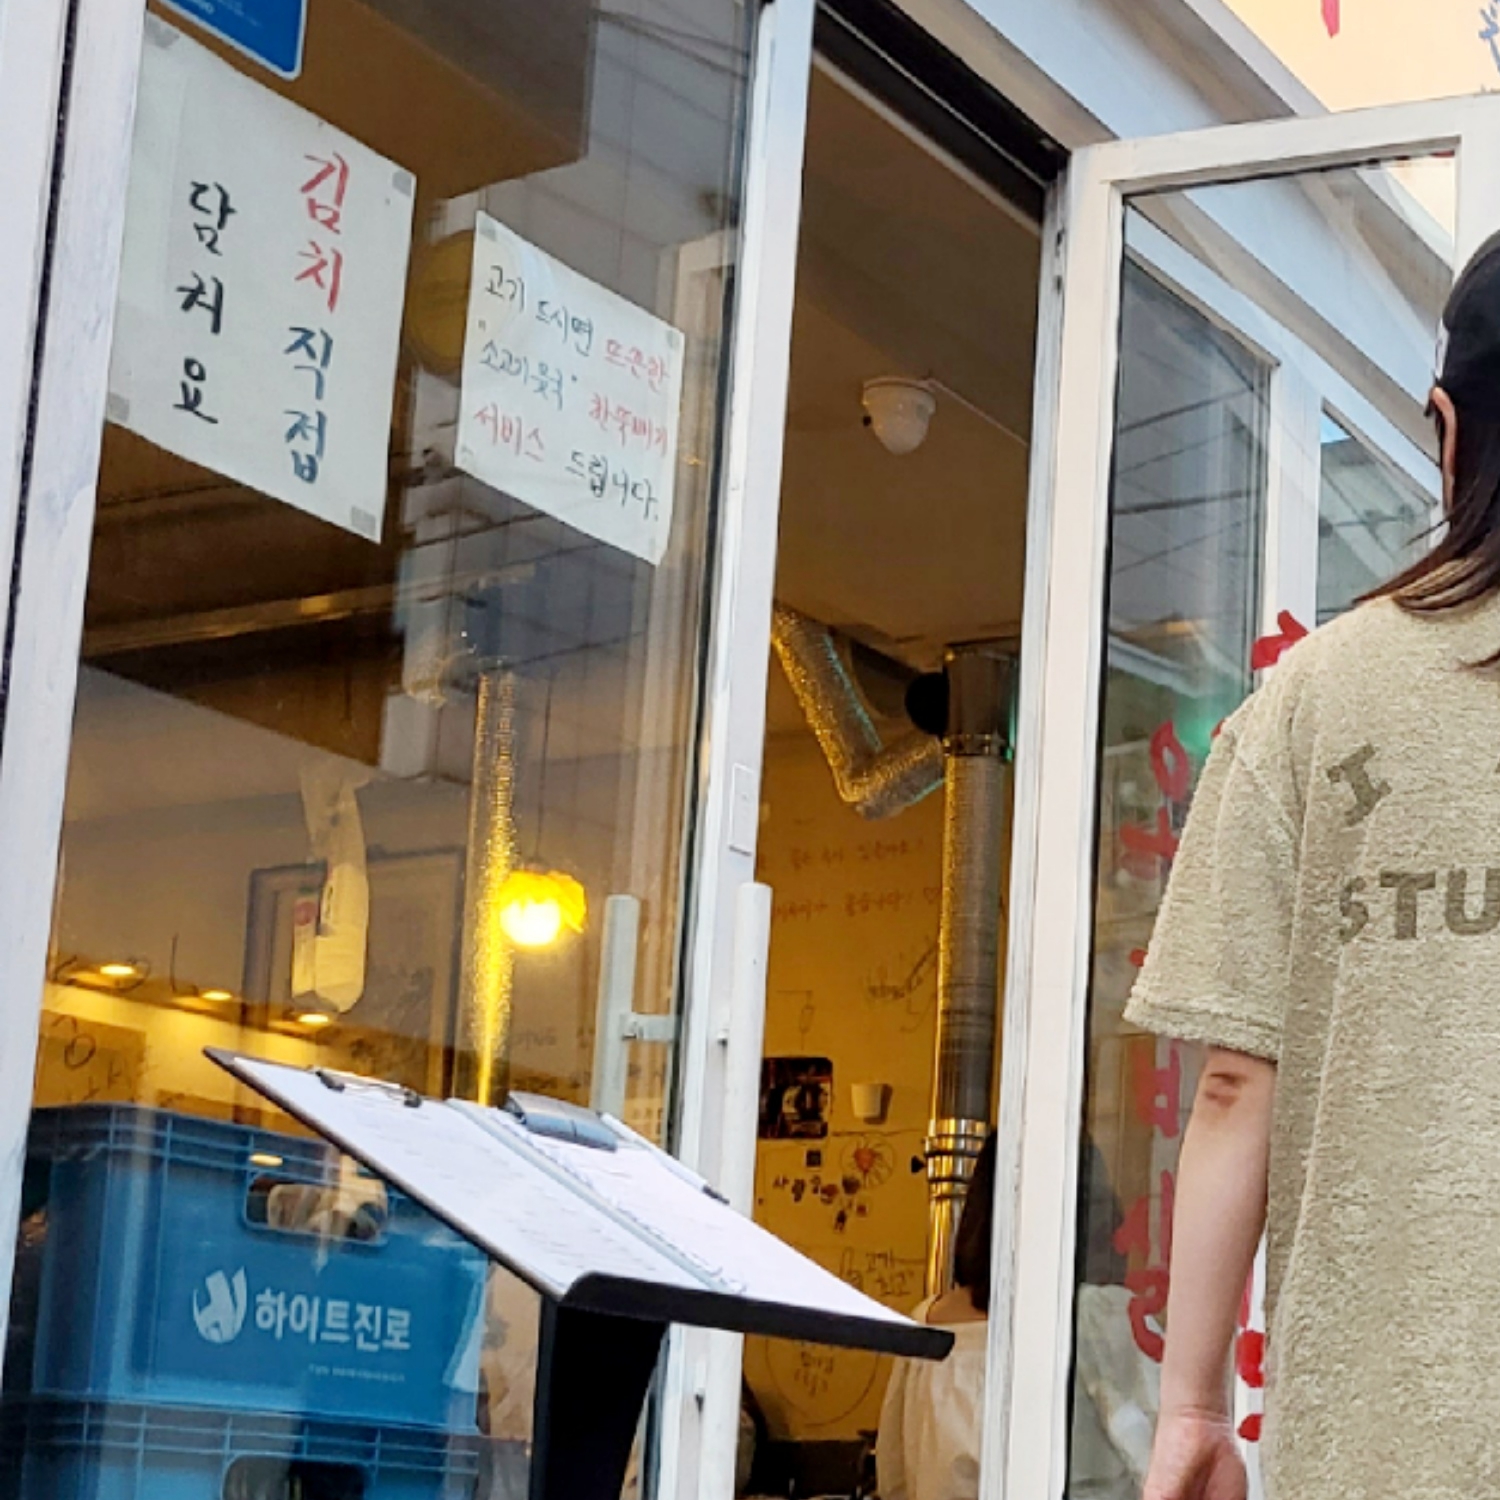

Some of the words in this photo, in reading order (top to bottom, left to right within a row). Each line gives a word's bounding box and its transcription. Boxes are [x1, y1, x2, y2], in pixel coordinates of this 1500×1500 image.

[295, 152, 348, 313] 김치
[485, 265, 525, 313] 고기
[535, 301, 594, 356] 드시면
[284, 327, 333, 483] 직접
[474, 403, 545, 462] 서비스
[255, 1287, 411, 1352] 하이트진로
